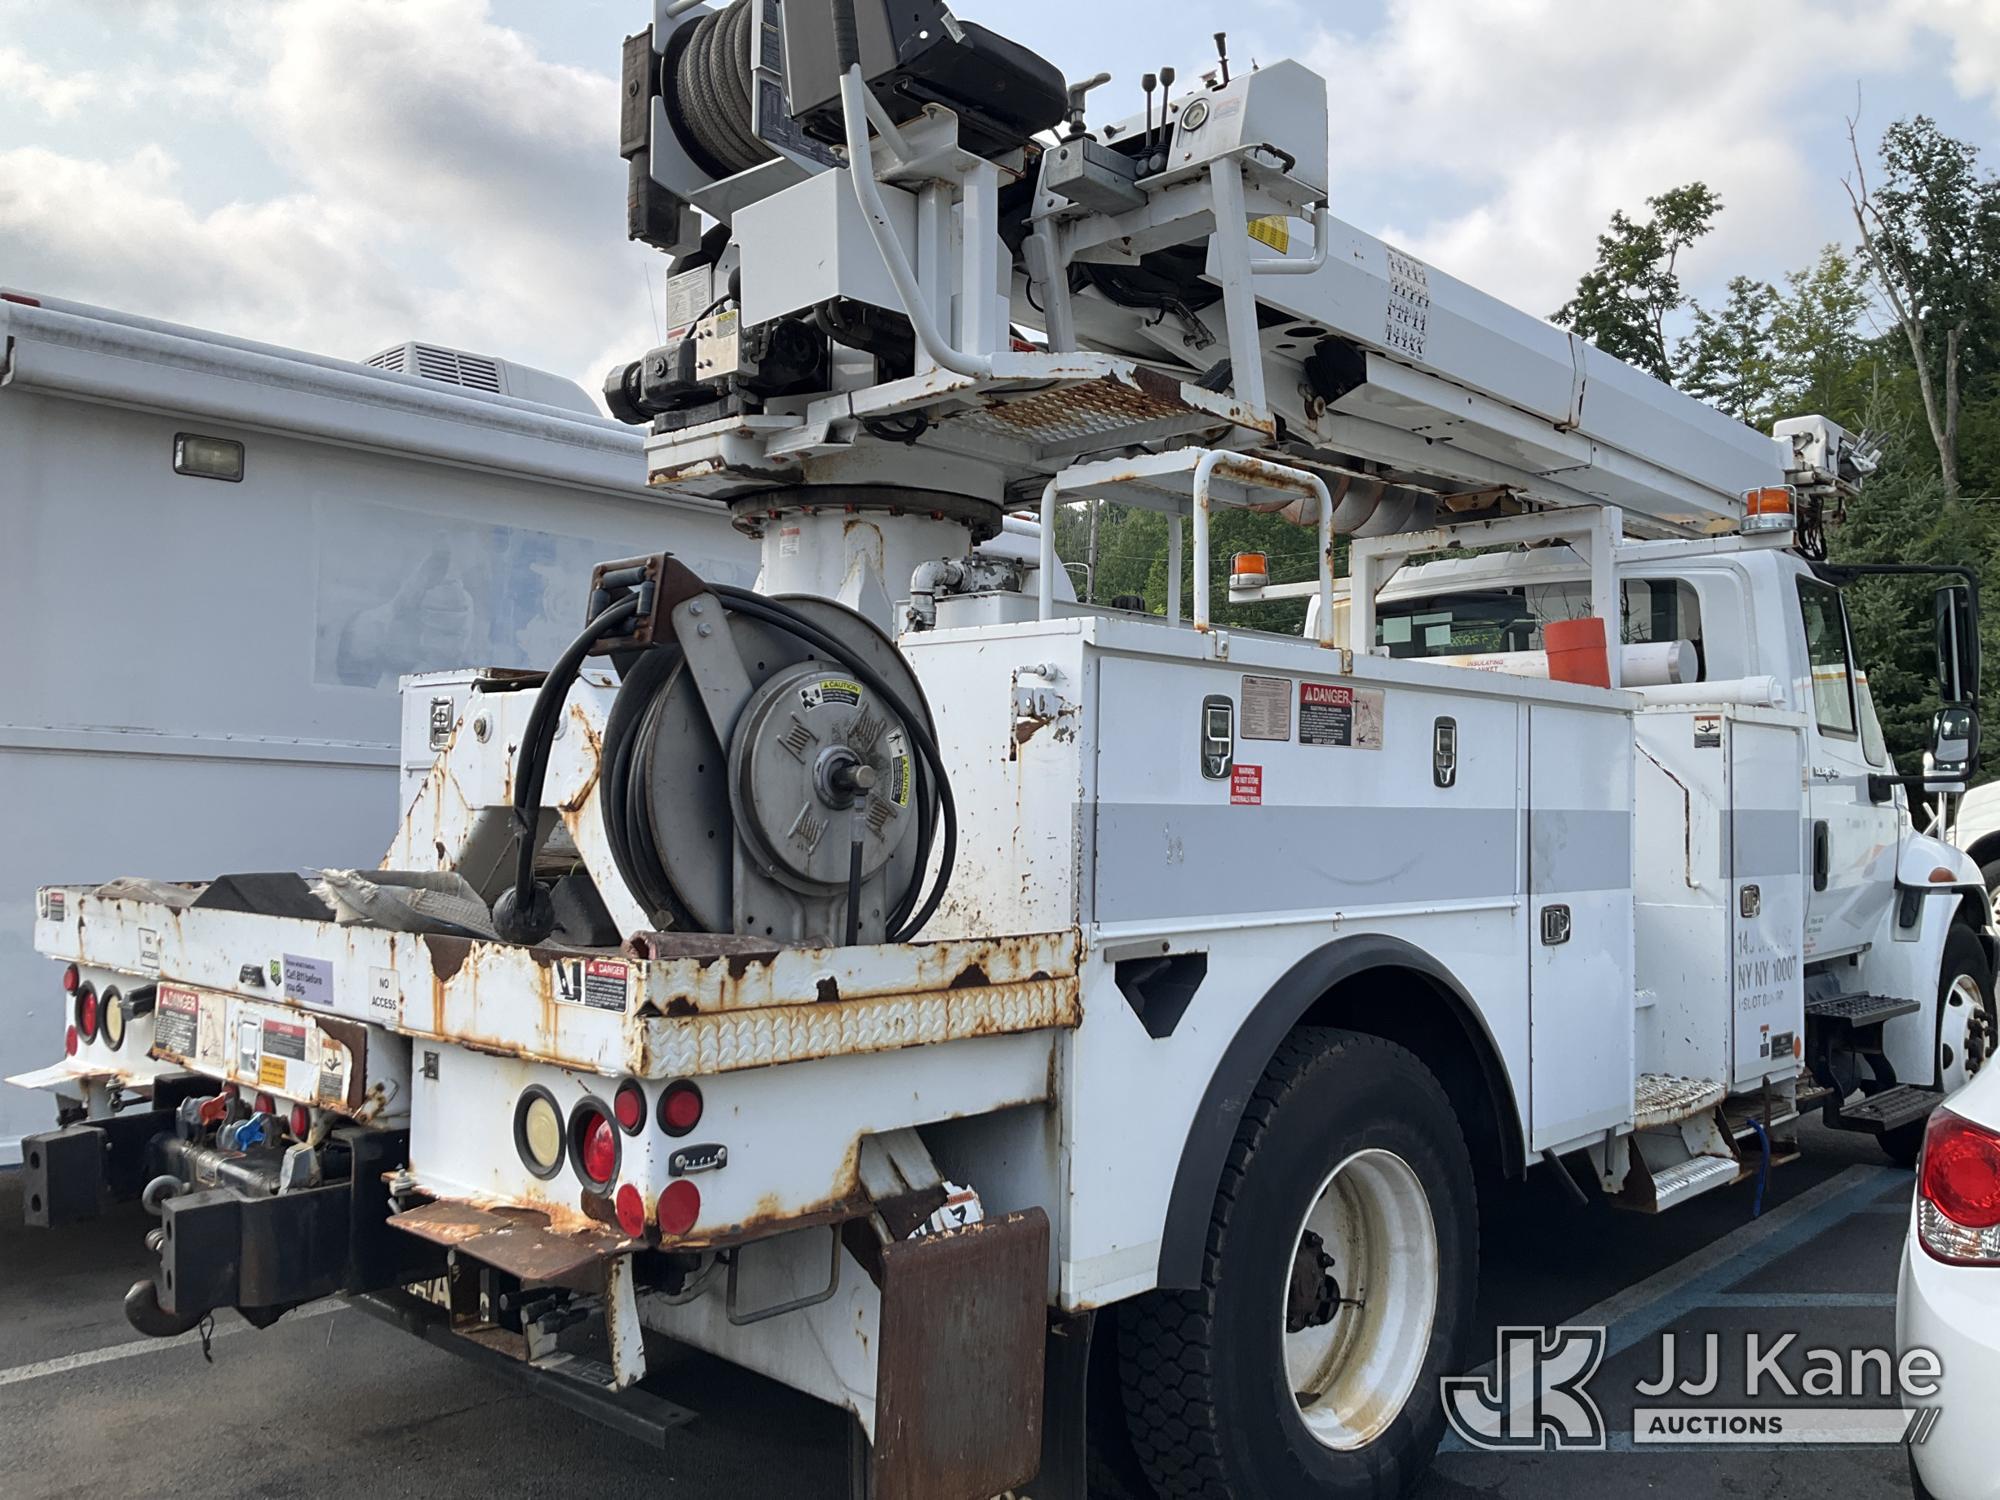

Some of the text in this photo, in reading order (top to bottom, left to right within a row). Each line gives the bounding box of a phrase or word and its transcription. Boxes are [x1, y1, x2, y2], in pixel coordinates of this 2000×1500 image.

[829, 681, 858, 692] CAUTION
[1313, 687, 1349, 704] DANGER
[901, 766, 909, 803] CAUTION
[599, 964, 625, 976] DANGER
[1738, 963, 1752, 991] NY
[1755, 960, 1769, 987] NY
[305, 973, 322, 985] before
[379, 977, 390, 989] NO
[168, 990, 196, 1011] DANGER
[372, 996, 397, 1010] ACCESS
